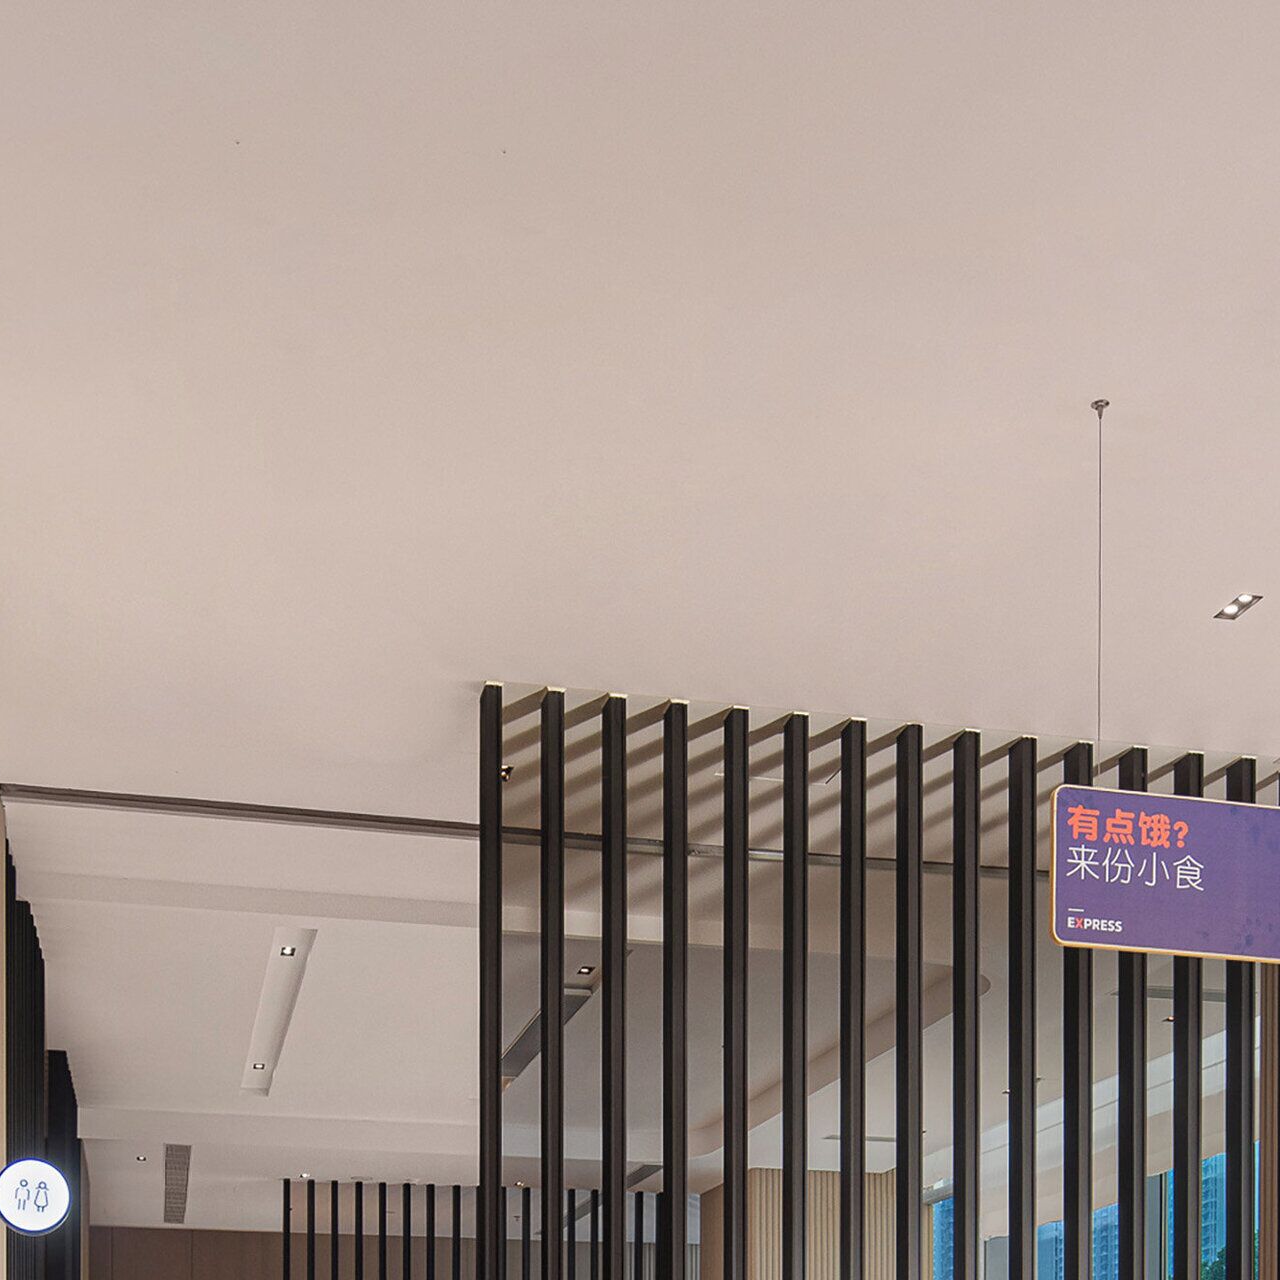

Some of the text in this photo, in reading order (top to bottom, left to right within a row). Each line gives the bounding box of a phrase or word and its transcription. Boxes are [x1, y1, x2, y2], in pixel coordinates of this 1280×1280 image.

[1067, 804, 1189, 849] 有点饿?
[1066, 844, 1204, 892] 来份小食
[1067, 916, 1123, 933] EXPRESS
